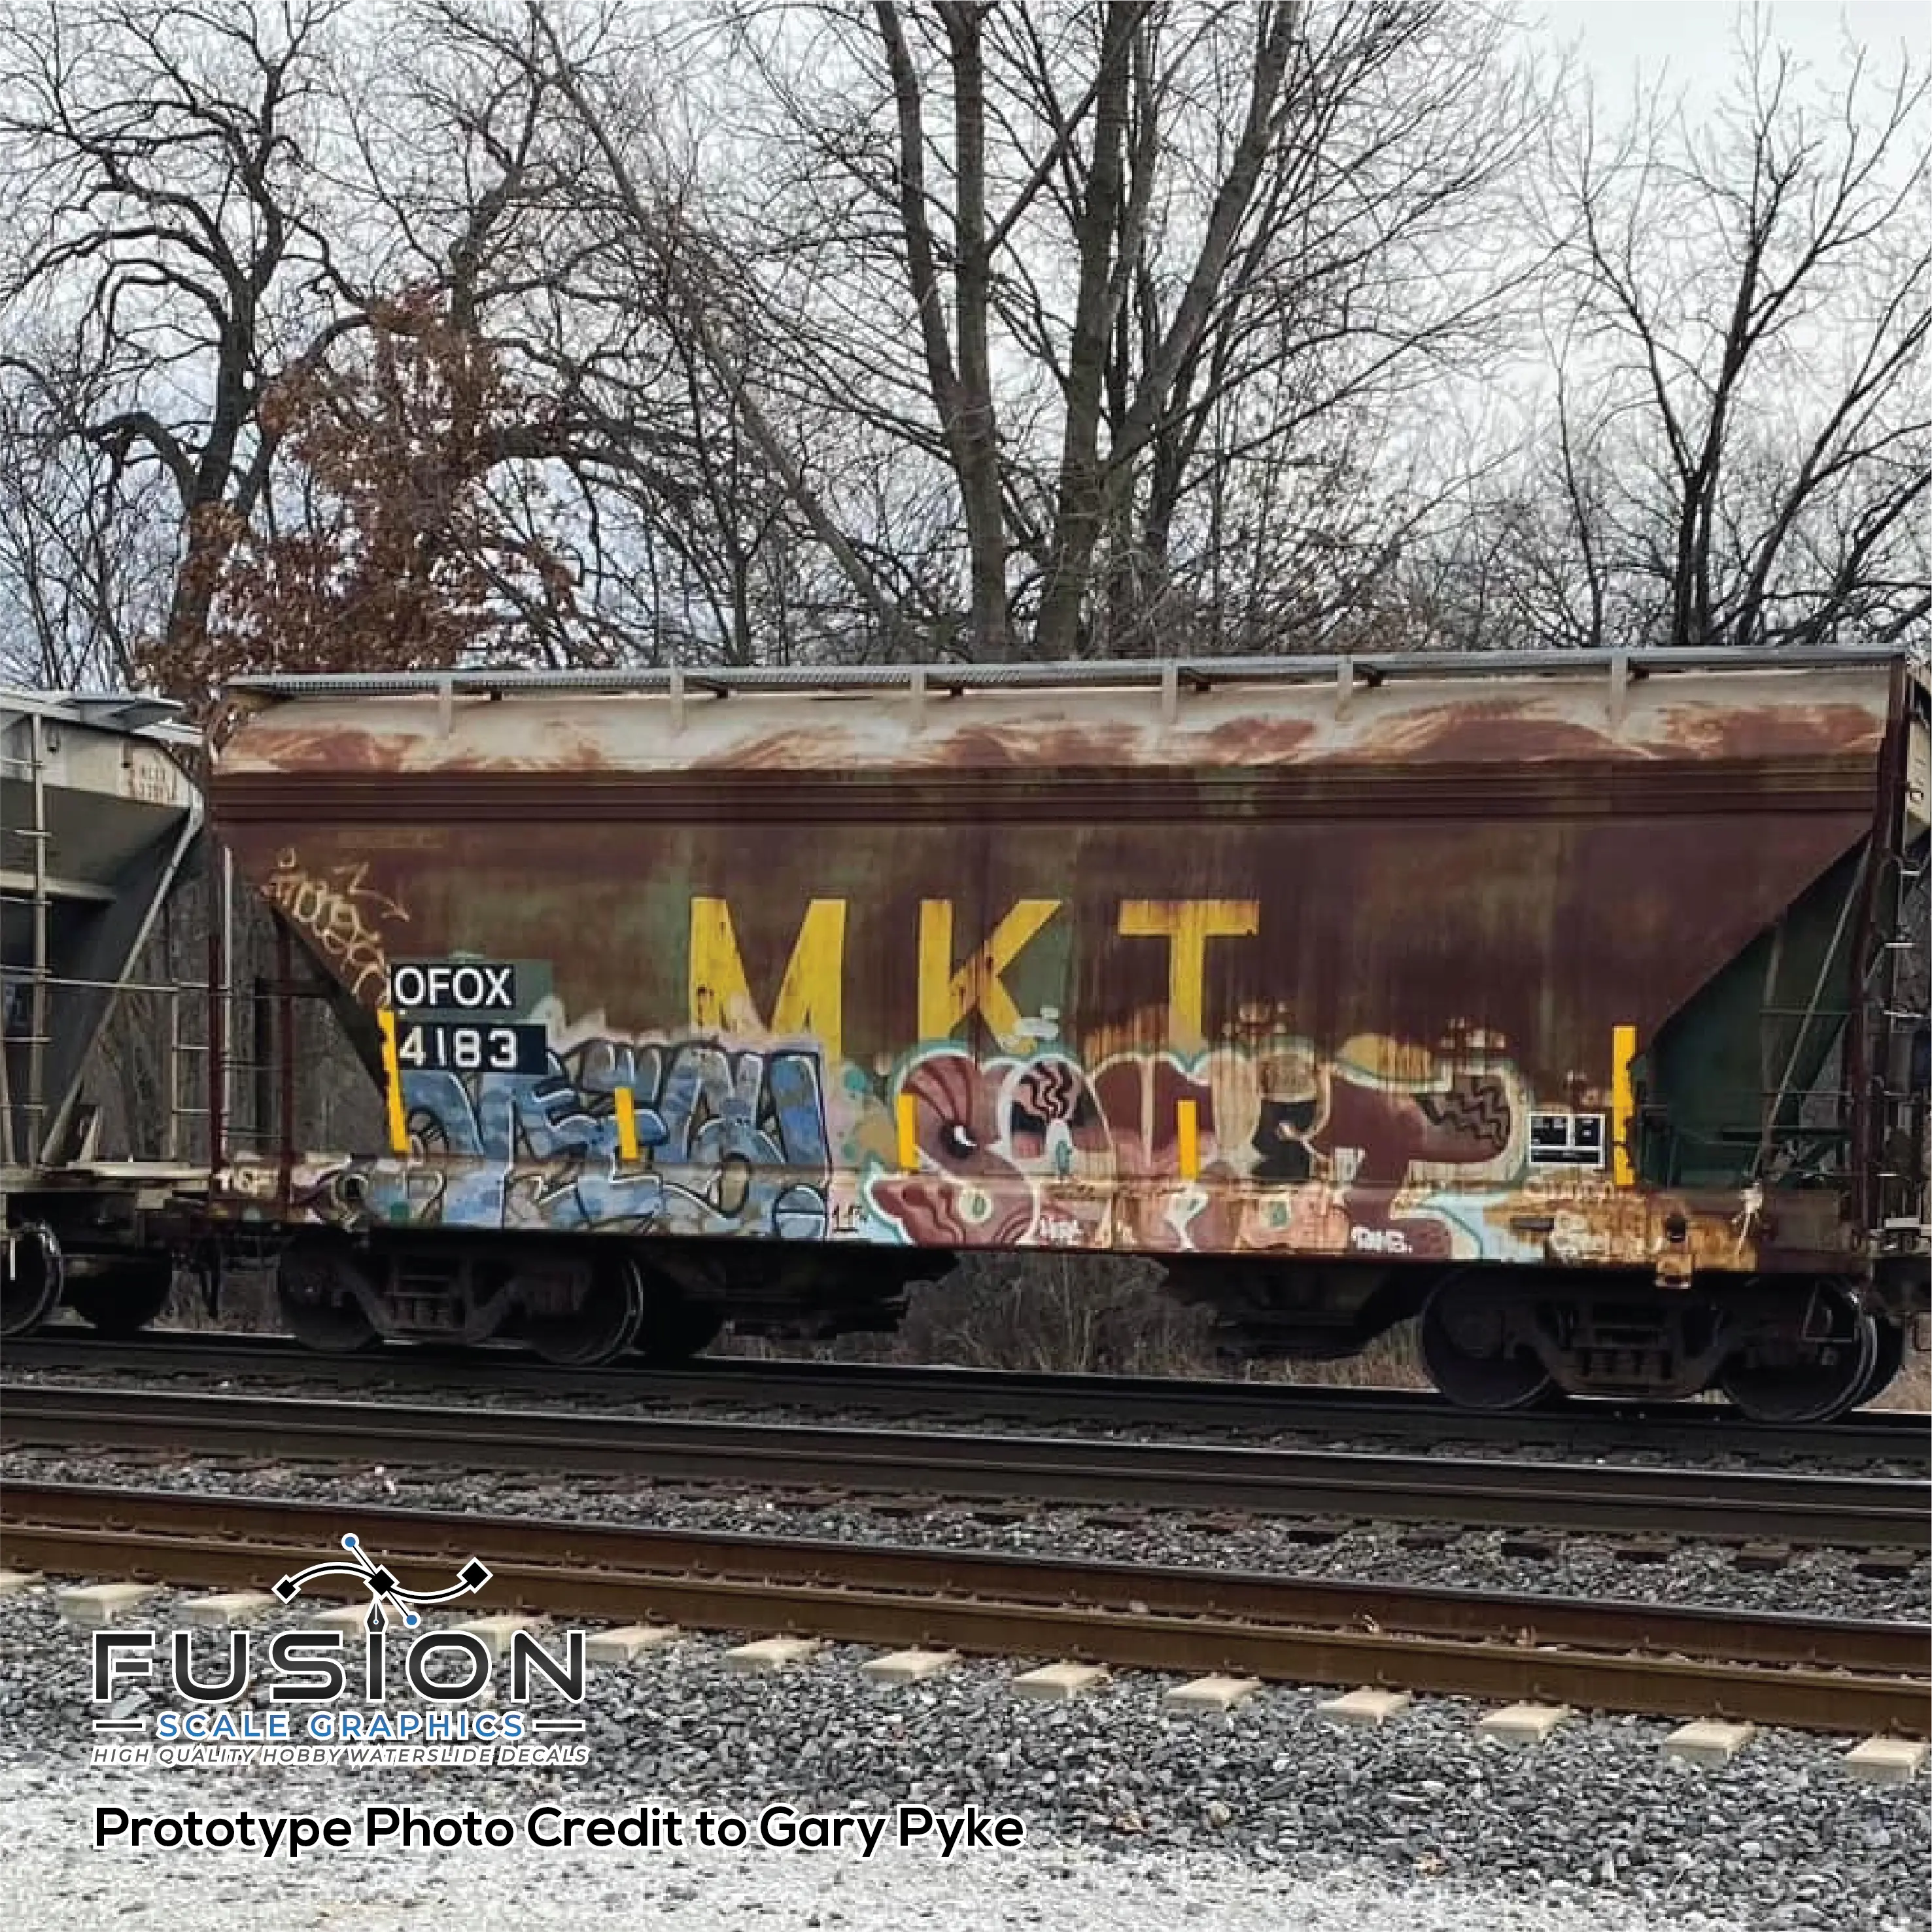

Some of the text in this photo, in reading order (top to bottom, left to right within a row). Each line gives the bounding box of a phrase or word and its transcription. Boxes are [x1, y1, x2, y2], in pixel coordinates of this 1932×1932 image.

[394, 967, 513, 1007] OFOX
[690, 897, 1260, 1066] MKT
[399, 1028, 519, 1069] 4183
